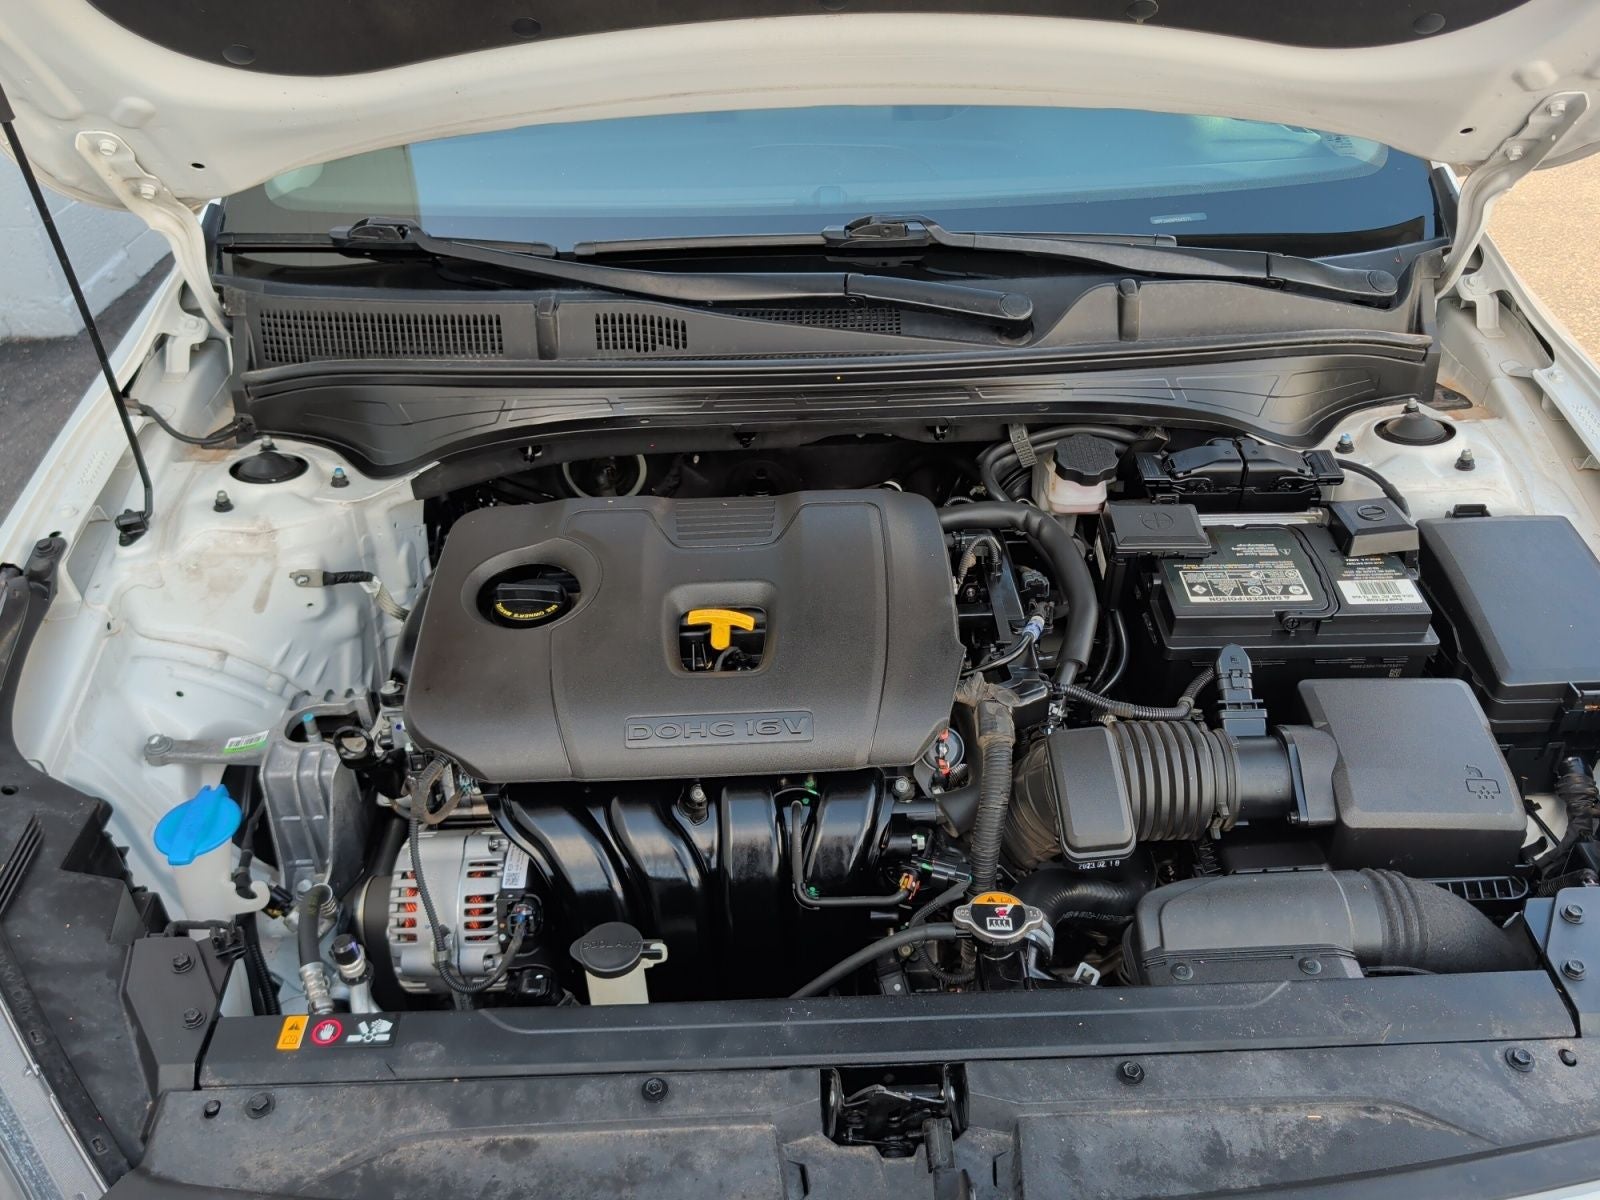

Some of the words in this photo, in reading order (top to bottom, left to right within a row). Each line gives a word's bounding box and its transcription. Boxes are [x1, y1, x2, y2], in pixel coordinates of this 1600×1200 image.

[627, 720, 735, 741] DOHC
[746, 716, 810, 737] 16V
[583, 940, 641, 950] COOLANT
